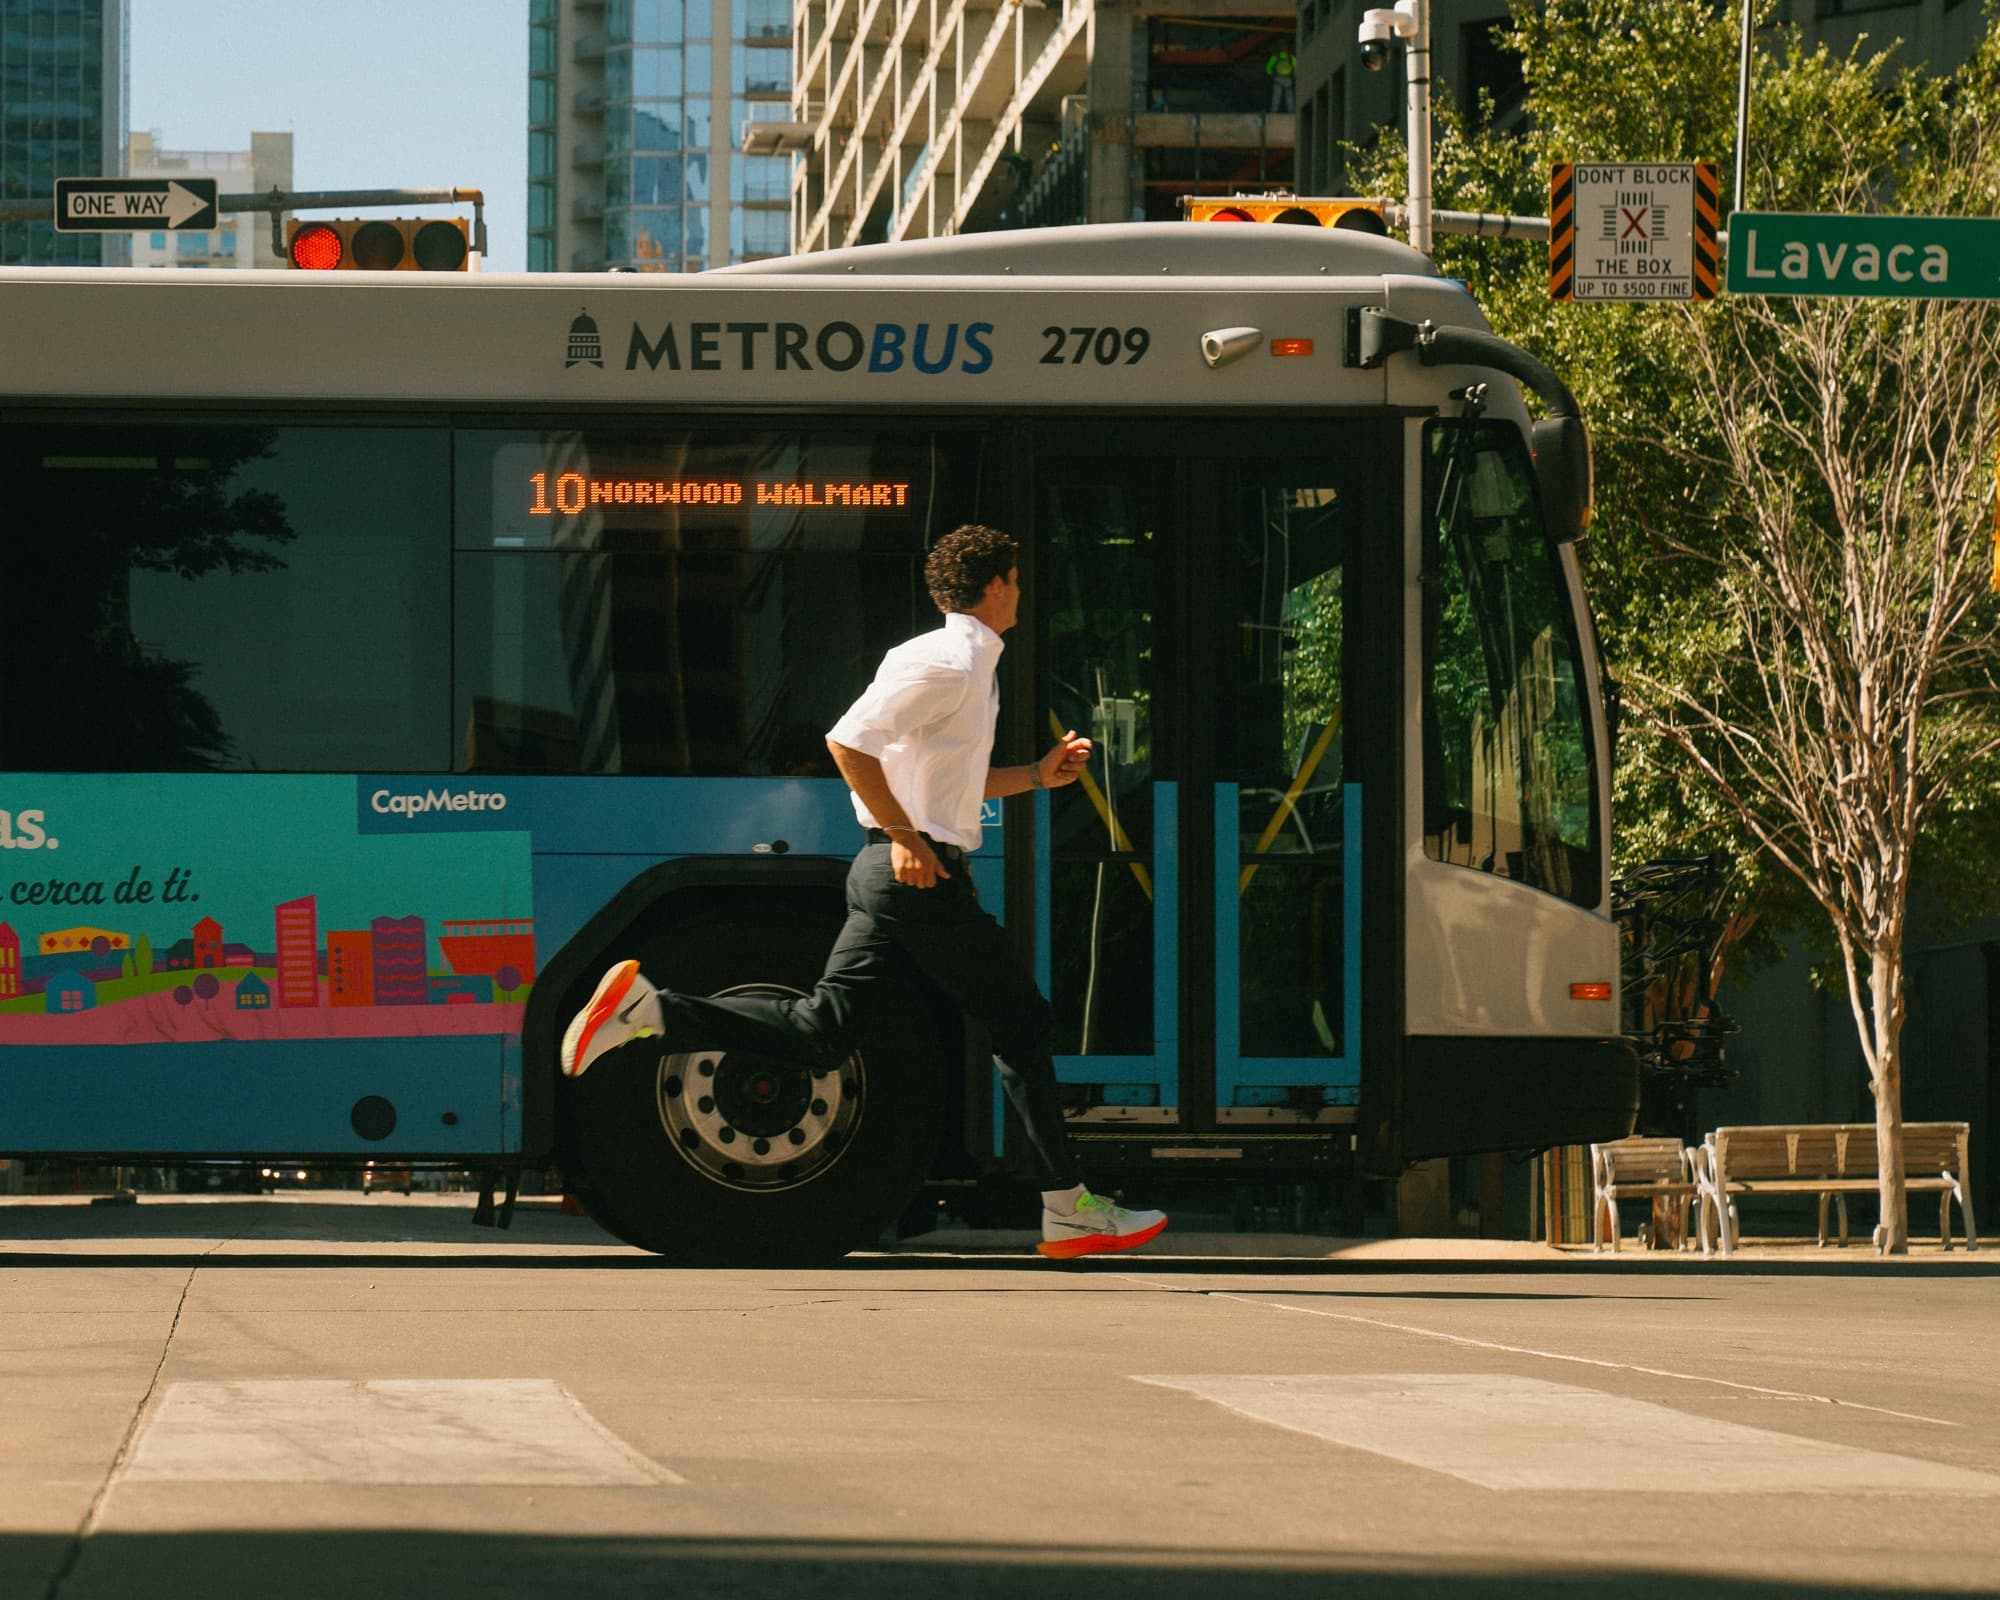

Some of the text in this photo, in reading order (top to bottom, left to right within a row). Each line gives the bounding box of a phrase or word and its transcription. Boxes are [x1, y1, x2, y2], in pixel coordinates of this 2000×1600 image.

[1578, 169, 1691, 184] DON'T BLOCK
[73, 195, 168, 215] ONE WAY
[1596, 259, 1672, 275] THE BOX
[1746, 229, 1949, 283] Lavaca
[1578, 282, 1689, 296] UP TO $500 FINE
[625, 320, 995, 375] METROBUS
[1038, 326, 1151, 366] 2709
[529, 473, 909, 515] 10 NORWOOD WALMART
[371, 788, 507, 819] CapMetro
[10, 865, 200, 905] cerca de ti.
